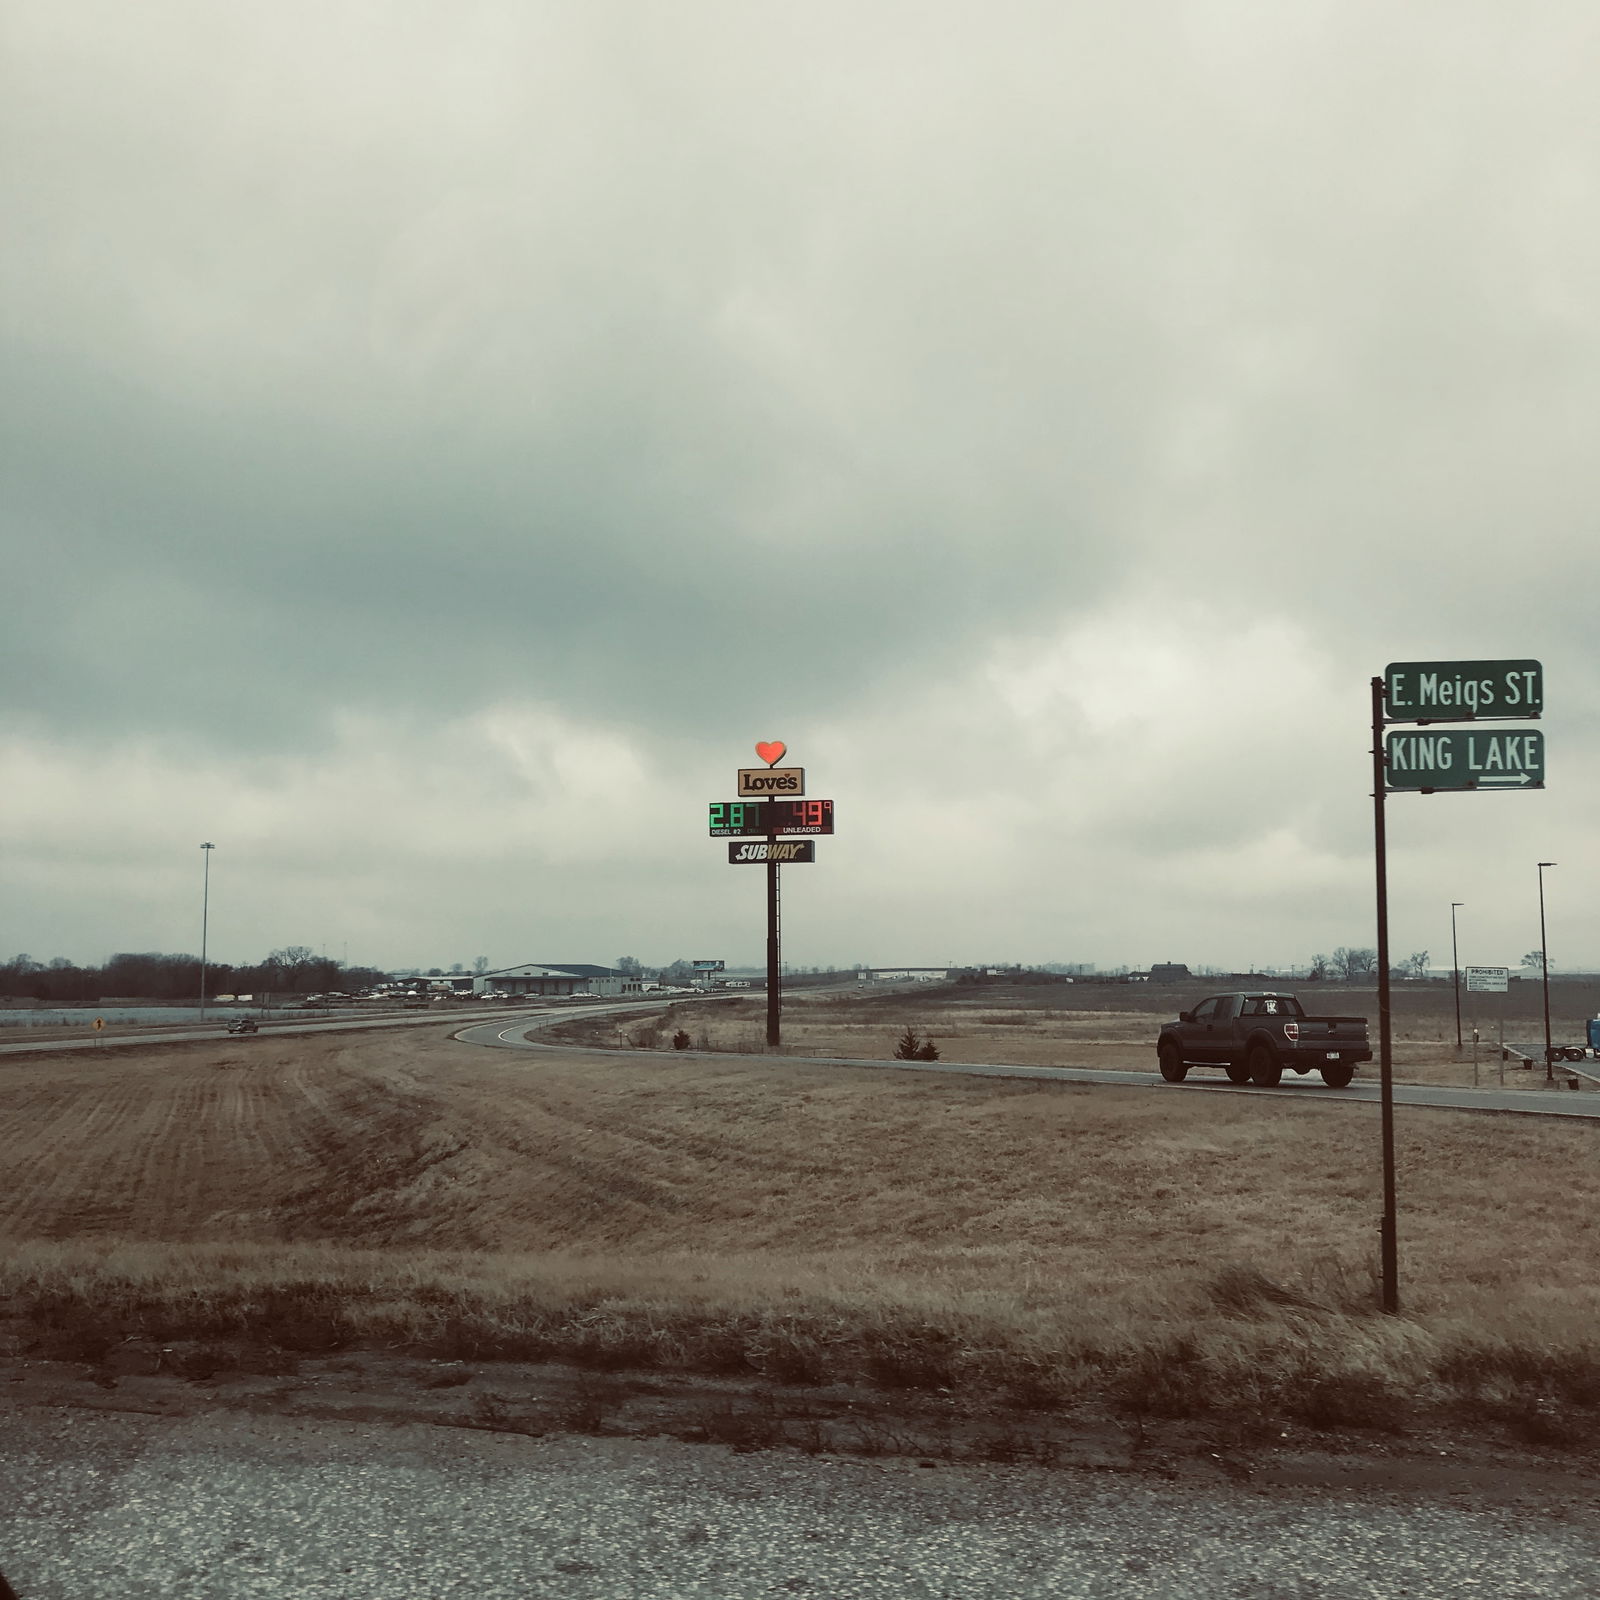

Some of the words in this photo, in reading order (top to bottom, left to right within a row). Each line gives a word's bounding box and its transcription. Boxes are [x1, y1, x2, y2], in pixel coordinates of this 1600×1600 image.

[1391, 673, 1413, 706] E.
[1505, 671, 1541, 705] ST.
[1391, 736, 1452, 770] KING
[1468, 736, 1539, 770] LAKE
[743, 773, 798, 791] Love's
[783, 826, 821, 834] UNLEADED
[735, 843, 805, 861] SUBWAY
